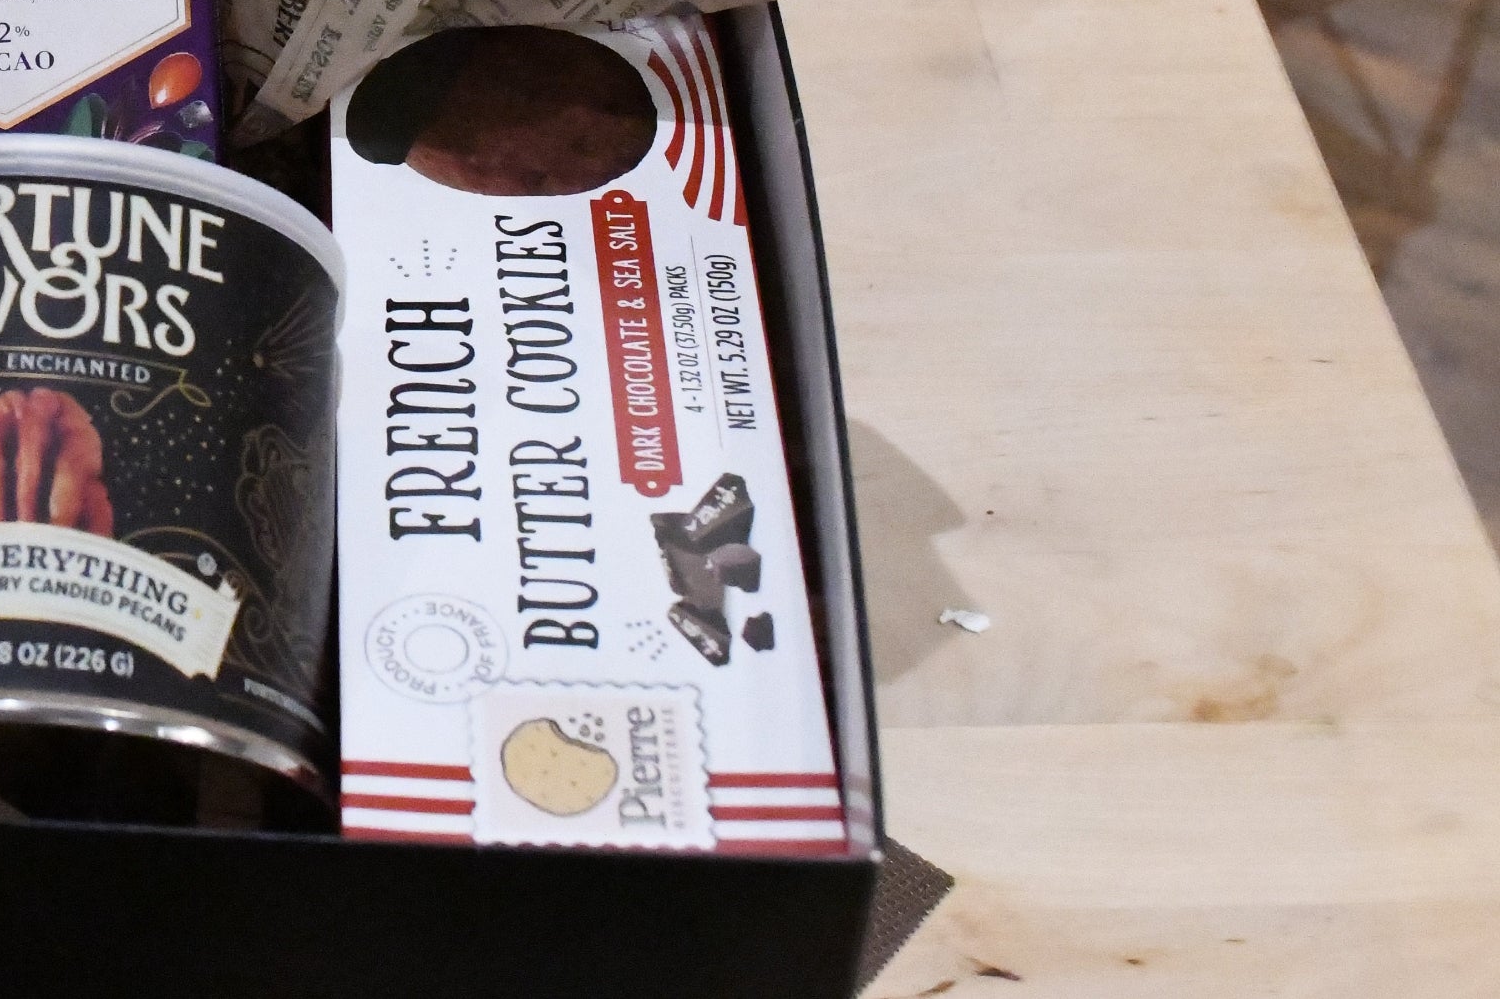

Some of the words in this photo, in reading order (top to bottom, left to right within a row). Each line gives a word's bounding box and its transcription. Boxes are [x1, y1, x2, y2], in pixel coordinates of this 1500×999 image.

[606, 210, 639, 251] SALT
[612, 258, 643, 289] SEA
[666, 265, 689, 299] PACKS
[704, 254, 741, 302] (150g)
[493, 214, 580, 415] COOKIES
[617, 297, 646, 310] &
[711, 306, 741, 325] OZ
[671, 302, 700, 349] (37.50g)
[677, 352, 698, 367] OZ
[714, 329, 747, 362] 5.29
[6, 352, 151, 384] ENCHANTED
[619, 317, 658, 417] CHOCOLATE
[679, 370, 702, 391] 1.32
[721, 368, 752, 395] WT.
[384, 297, 483, 543] FRENCH
[725, 400, 757, 430] NET
[631, 425, 665, 471] DARK
[508, 434, 601, 650] BUTTER
[29, 577, 113, 606] CANDIED
[118, 596, 186, 642] PECANS
[425, 602, 495, 649] FRANCE
[17, 642, 50, 667] OZ
[54, 644, 105, 673] (226
[110, 650, 134, 679] G)
[376, 626, 437, 695] PRODUCT
[474, 653, 494, 678] OF
[618, 706, 667, 829] Pierre
